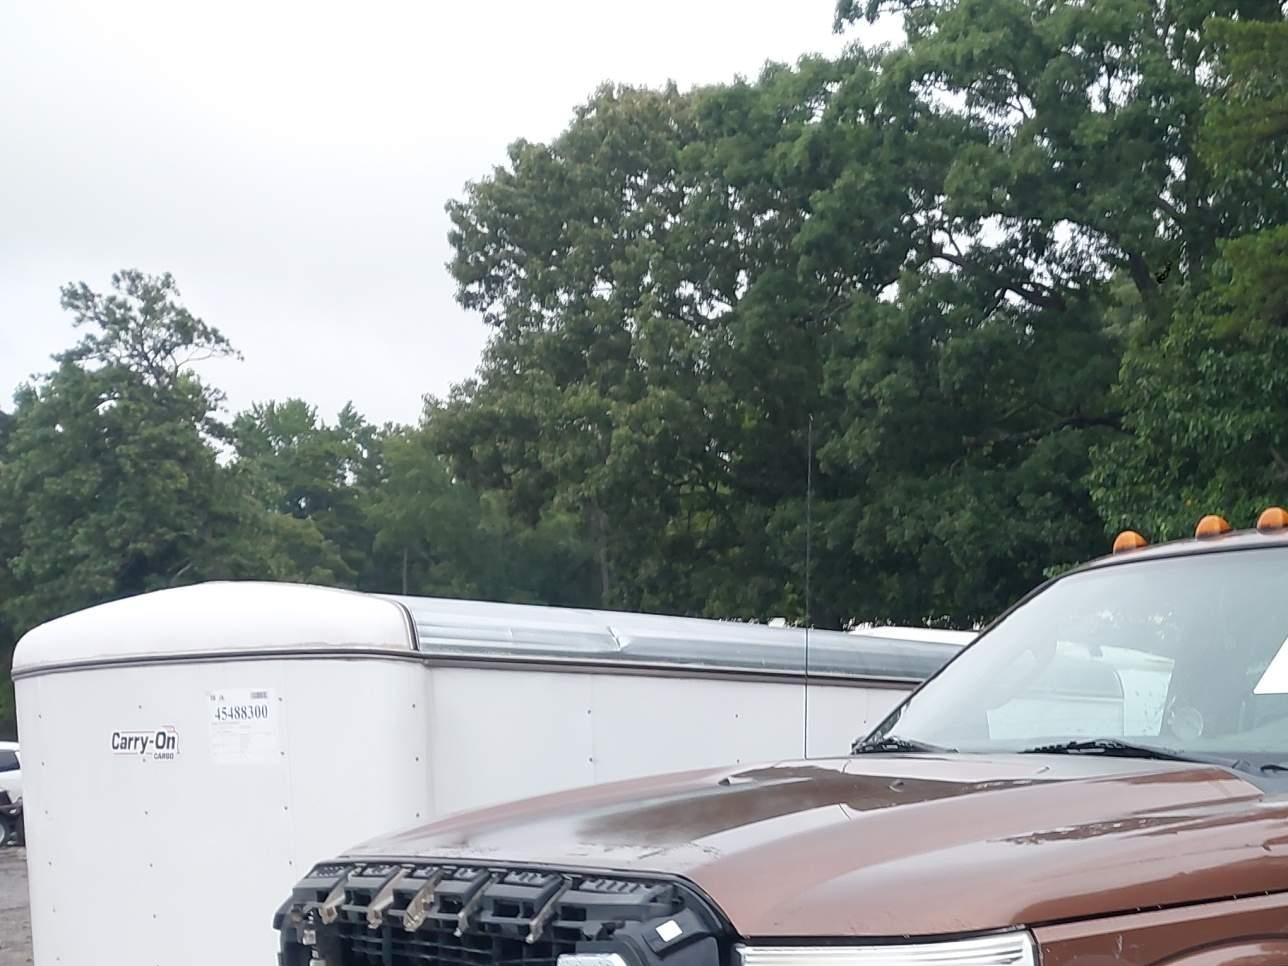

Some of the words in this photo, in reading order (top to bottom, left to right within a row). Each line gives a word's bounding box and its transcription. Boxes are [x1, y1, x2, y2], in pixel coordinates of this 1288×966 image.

[214, 704, 268, 721] 45488300
[111, 731, 176, 754] Carry-On
[153, 752, 175, 760] CARGO
